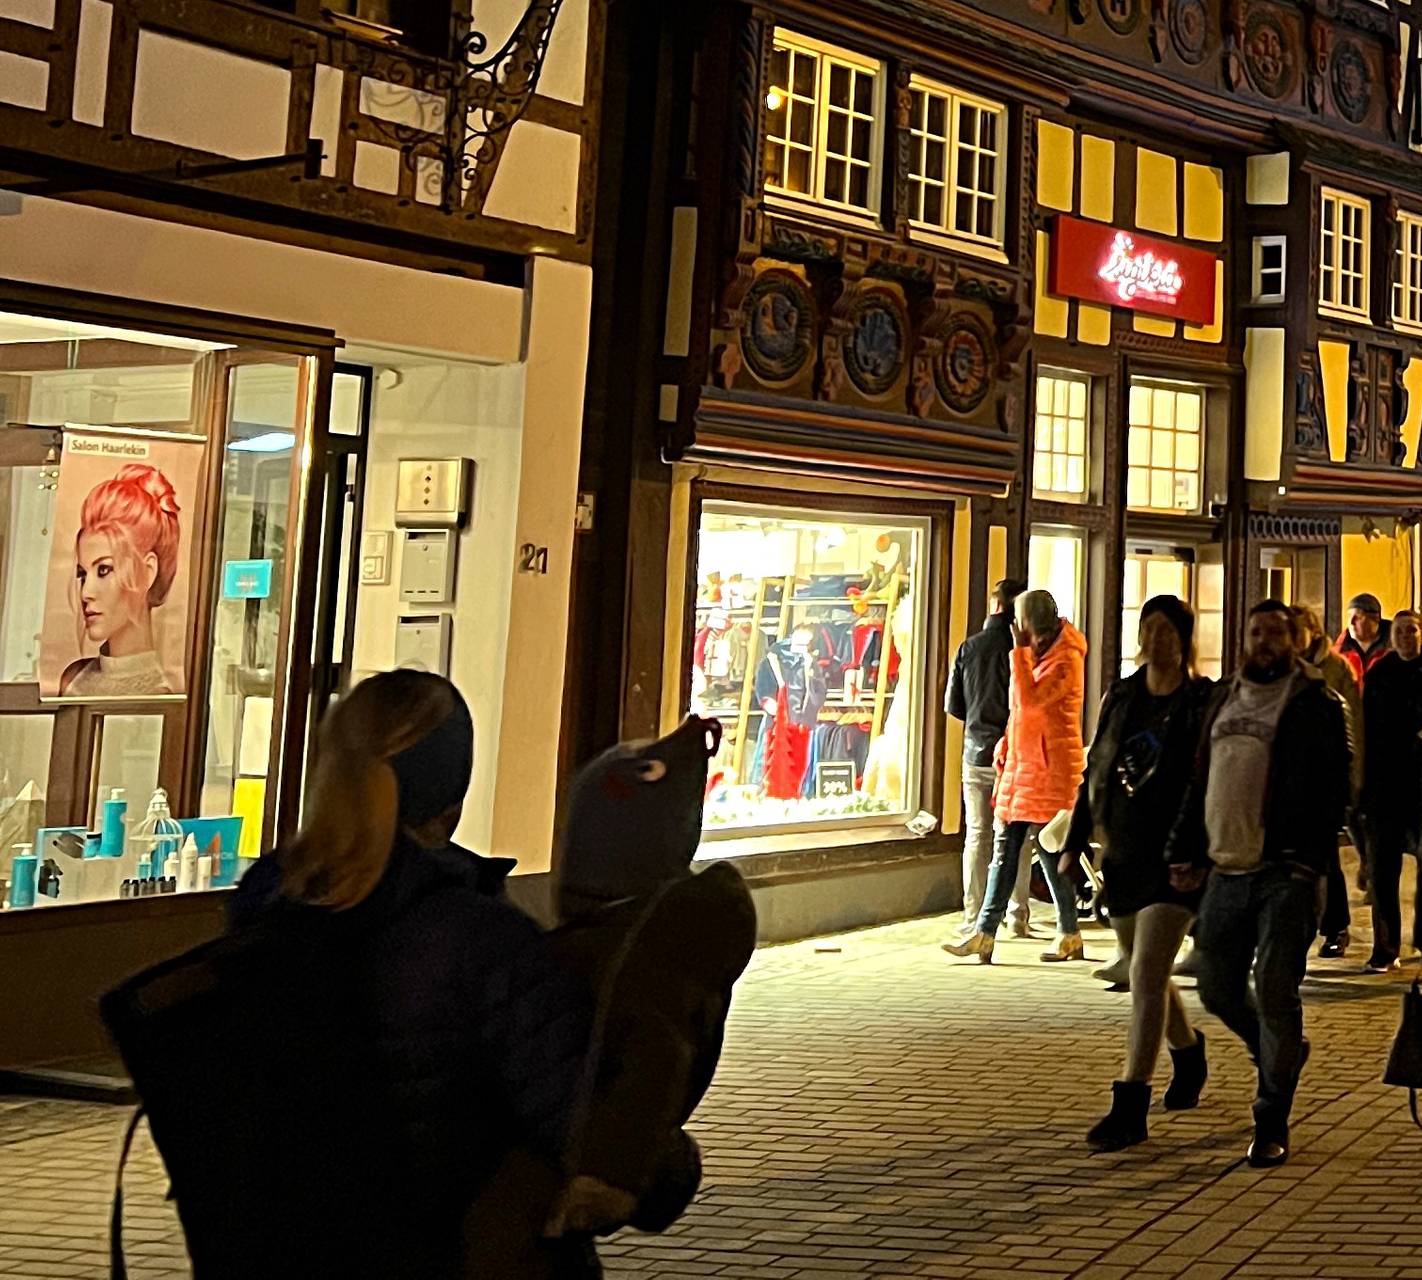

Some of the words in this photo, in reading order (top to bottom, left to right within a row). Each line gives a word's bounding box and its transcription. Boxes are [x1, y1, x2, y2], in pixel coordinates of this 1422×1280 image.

[71, 439, 99, 451] Salon
[101, 442, 146, 456] Haarlekin
[518, 543, 548, 574] 21
